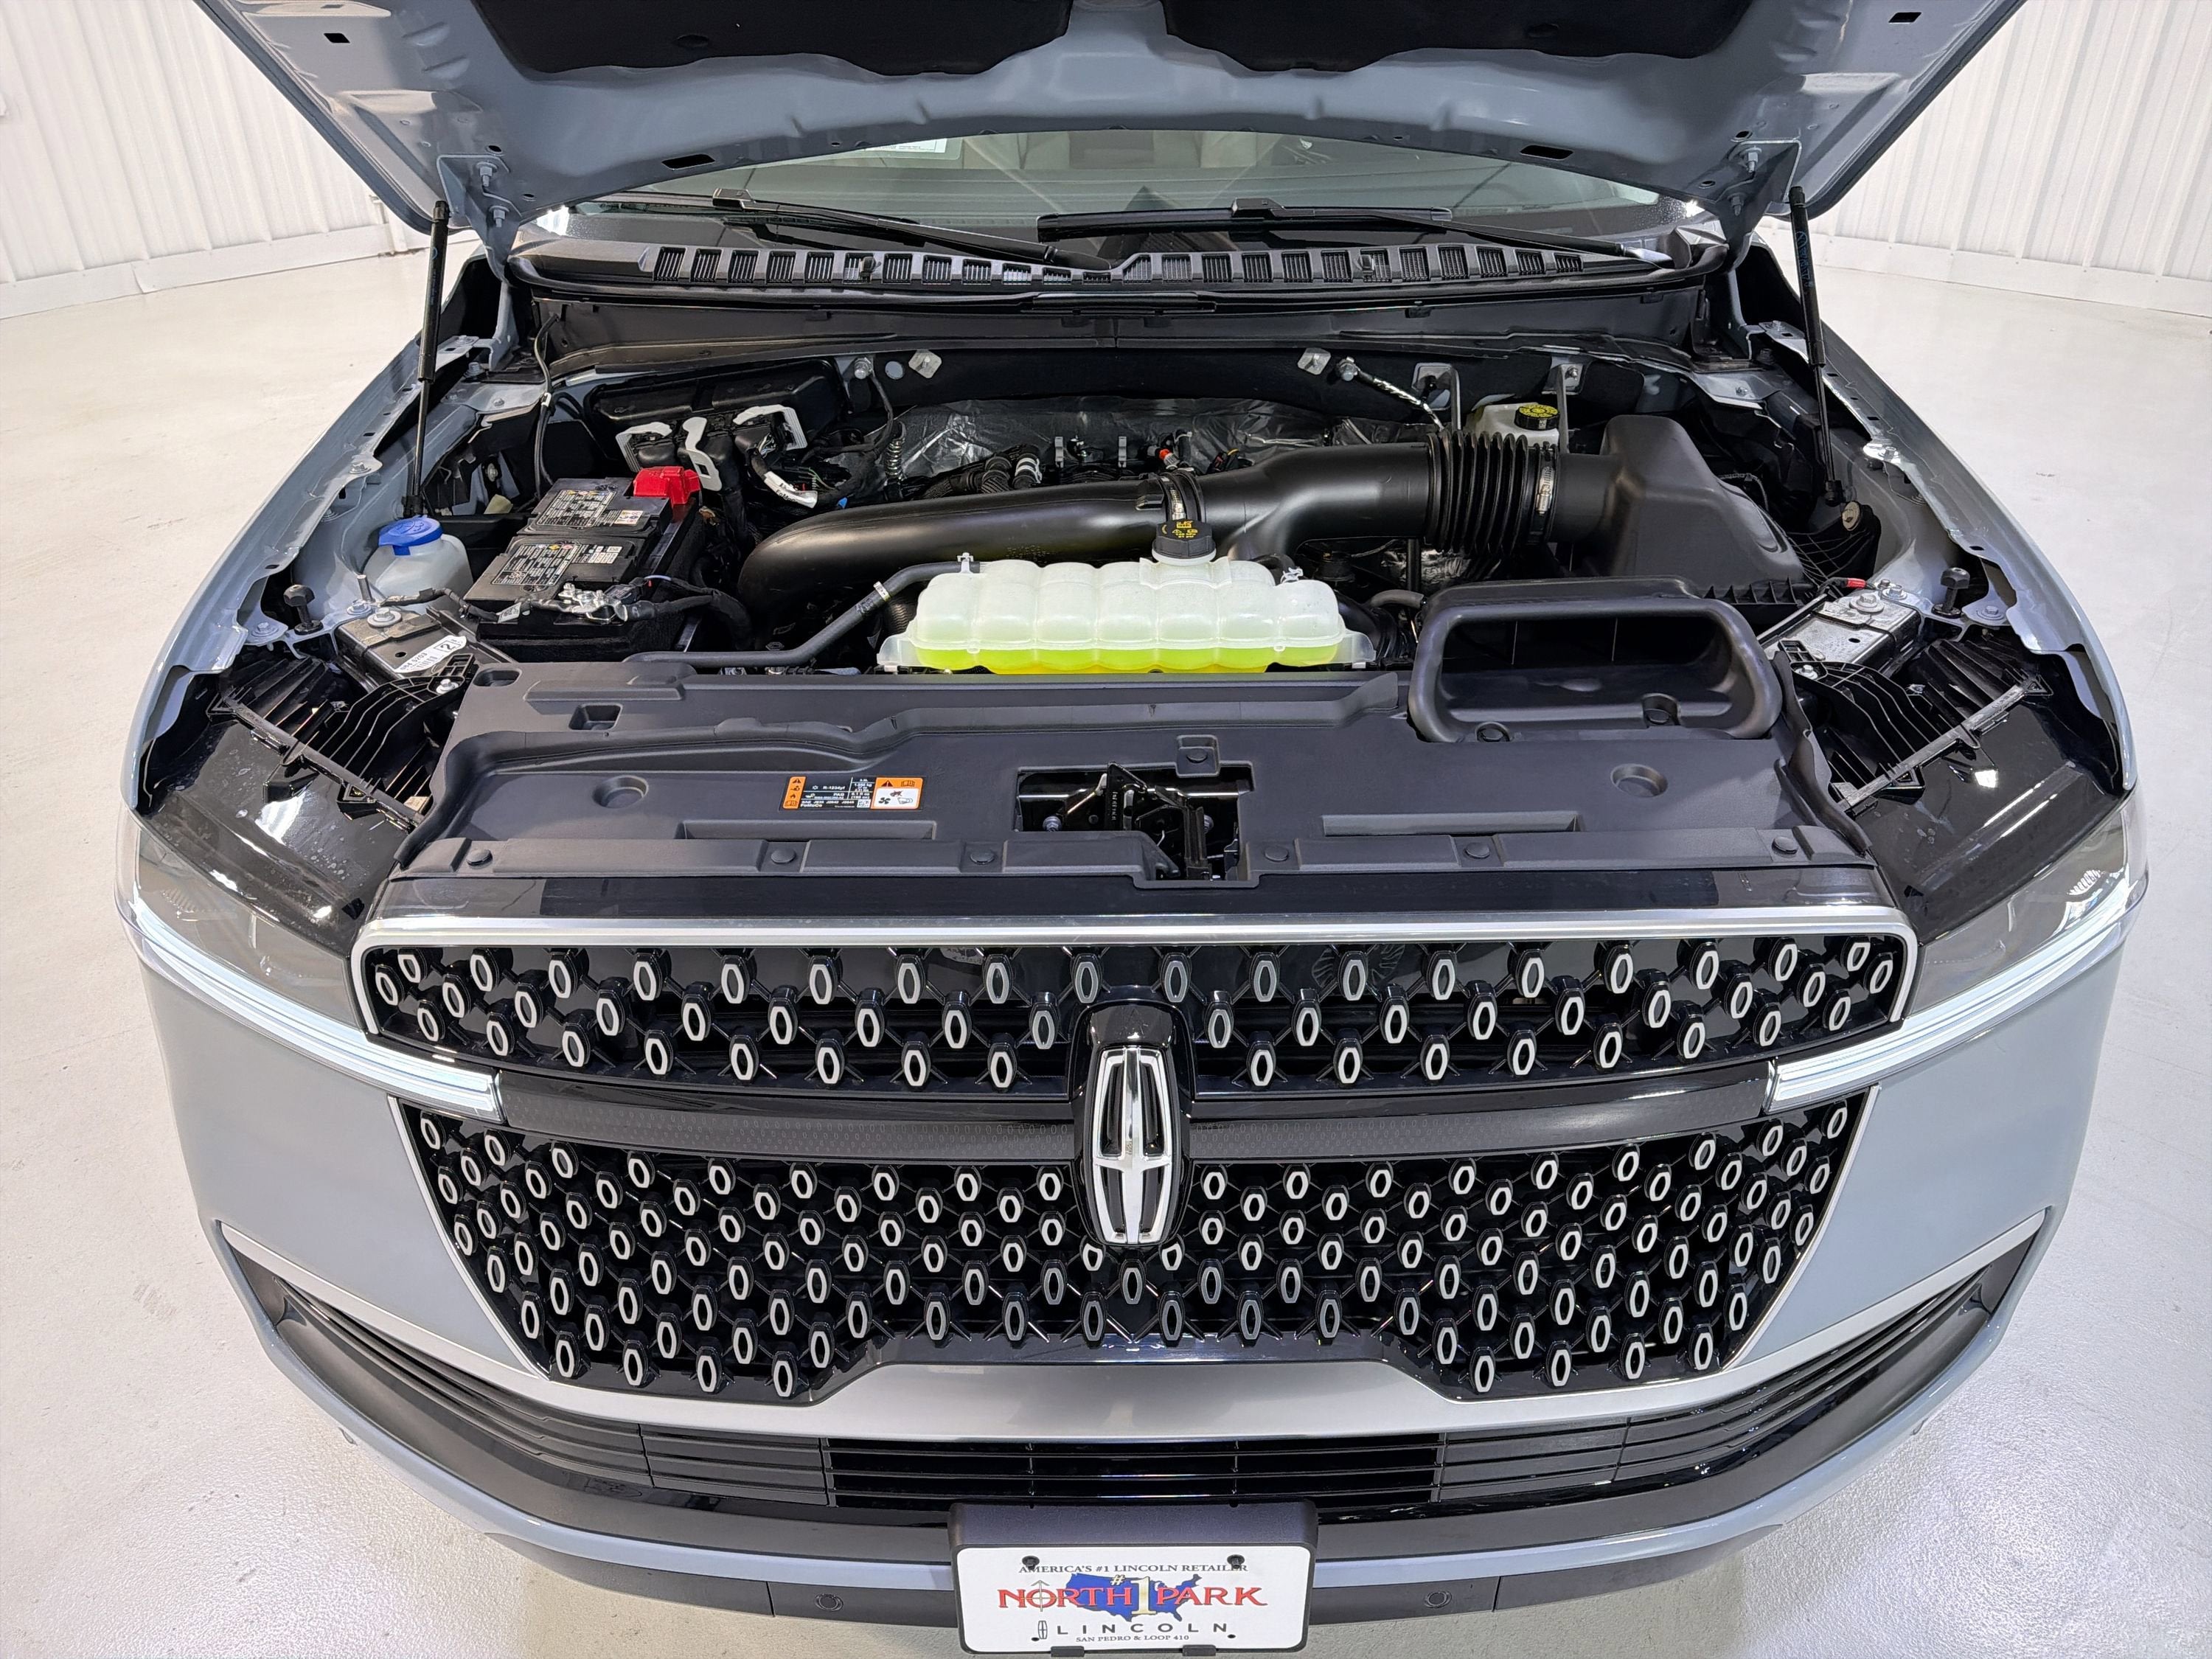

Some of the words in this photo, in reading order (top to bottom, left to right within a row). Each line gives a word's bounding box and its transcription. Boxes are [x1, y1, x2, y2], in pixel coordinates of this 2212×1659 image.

[1018, 1565, 1092, 1573] AMERICA'S
[1095, 1565, 1109, 1573] #1
[1114, 1564, 1178, 1573] LINCOLN
[1181, 1564, 1248, 1572] RETAILER
[997, 1586, 1133, 1608] NORTH
[1156, 1586, 1268, 1607] PARK
[1057, 1623, 1228, 1635] LINCOLN
